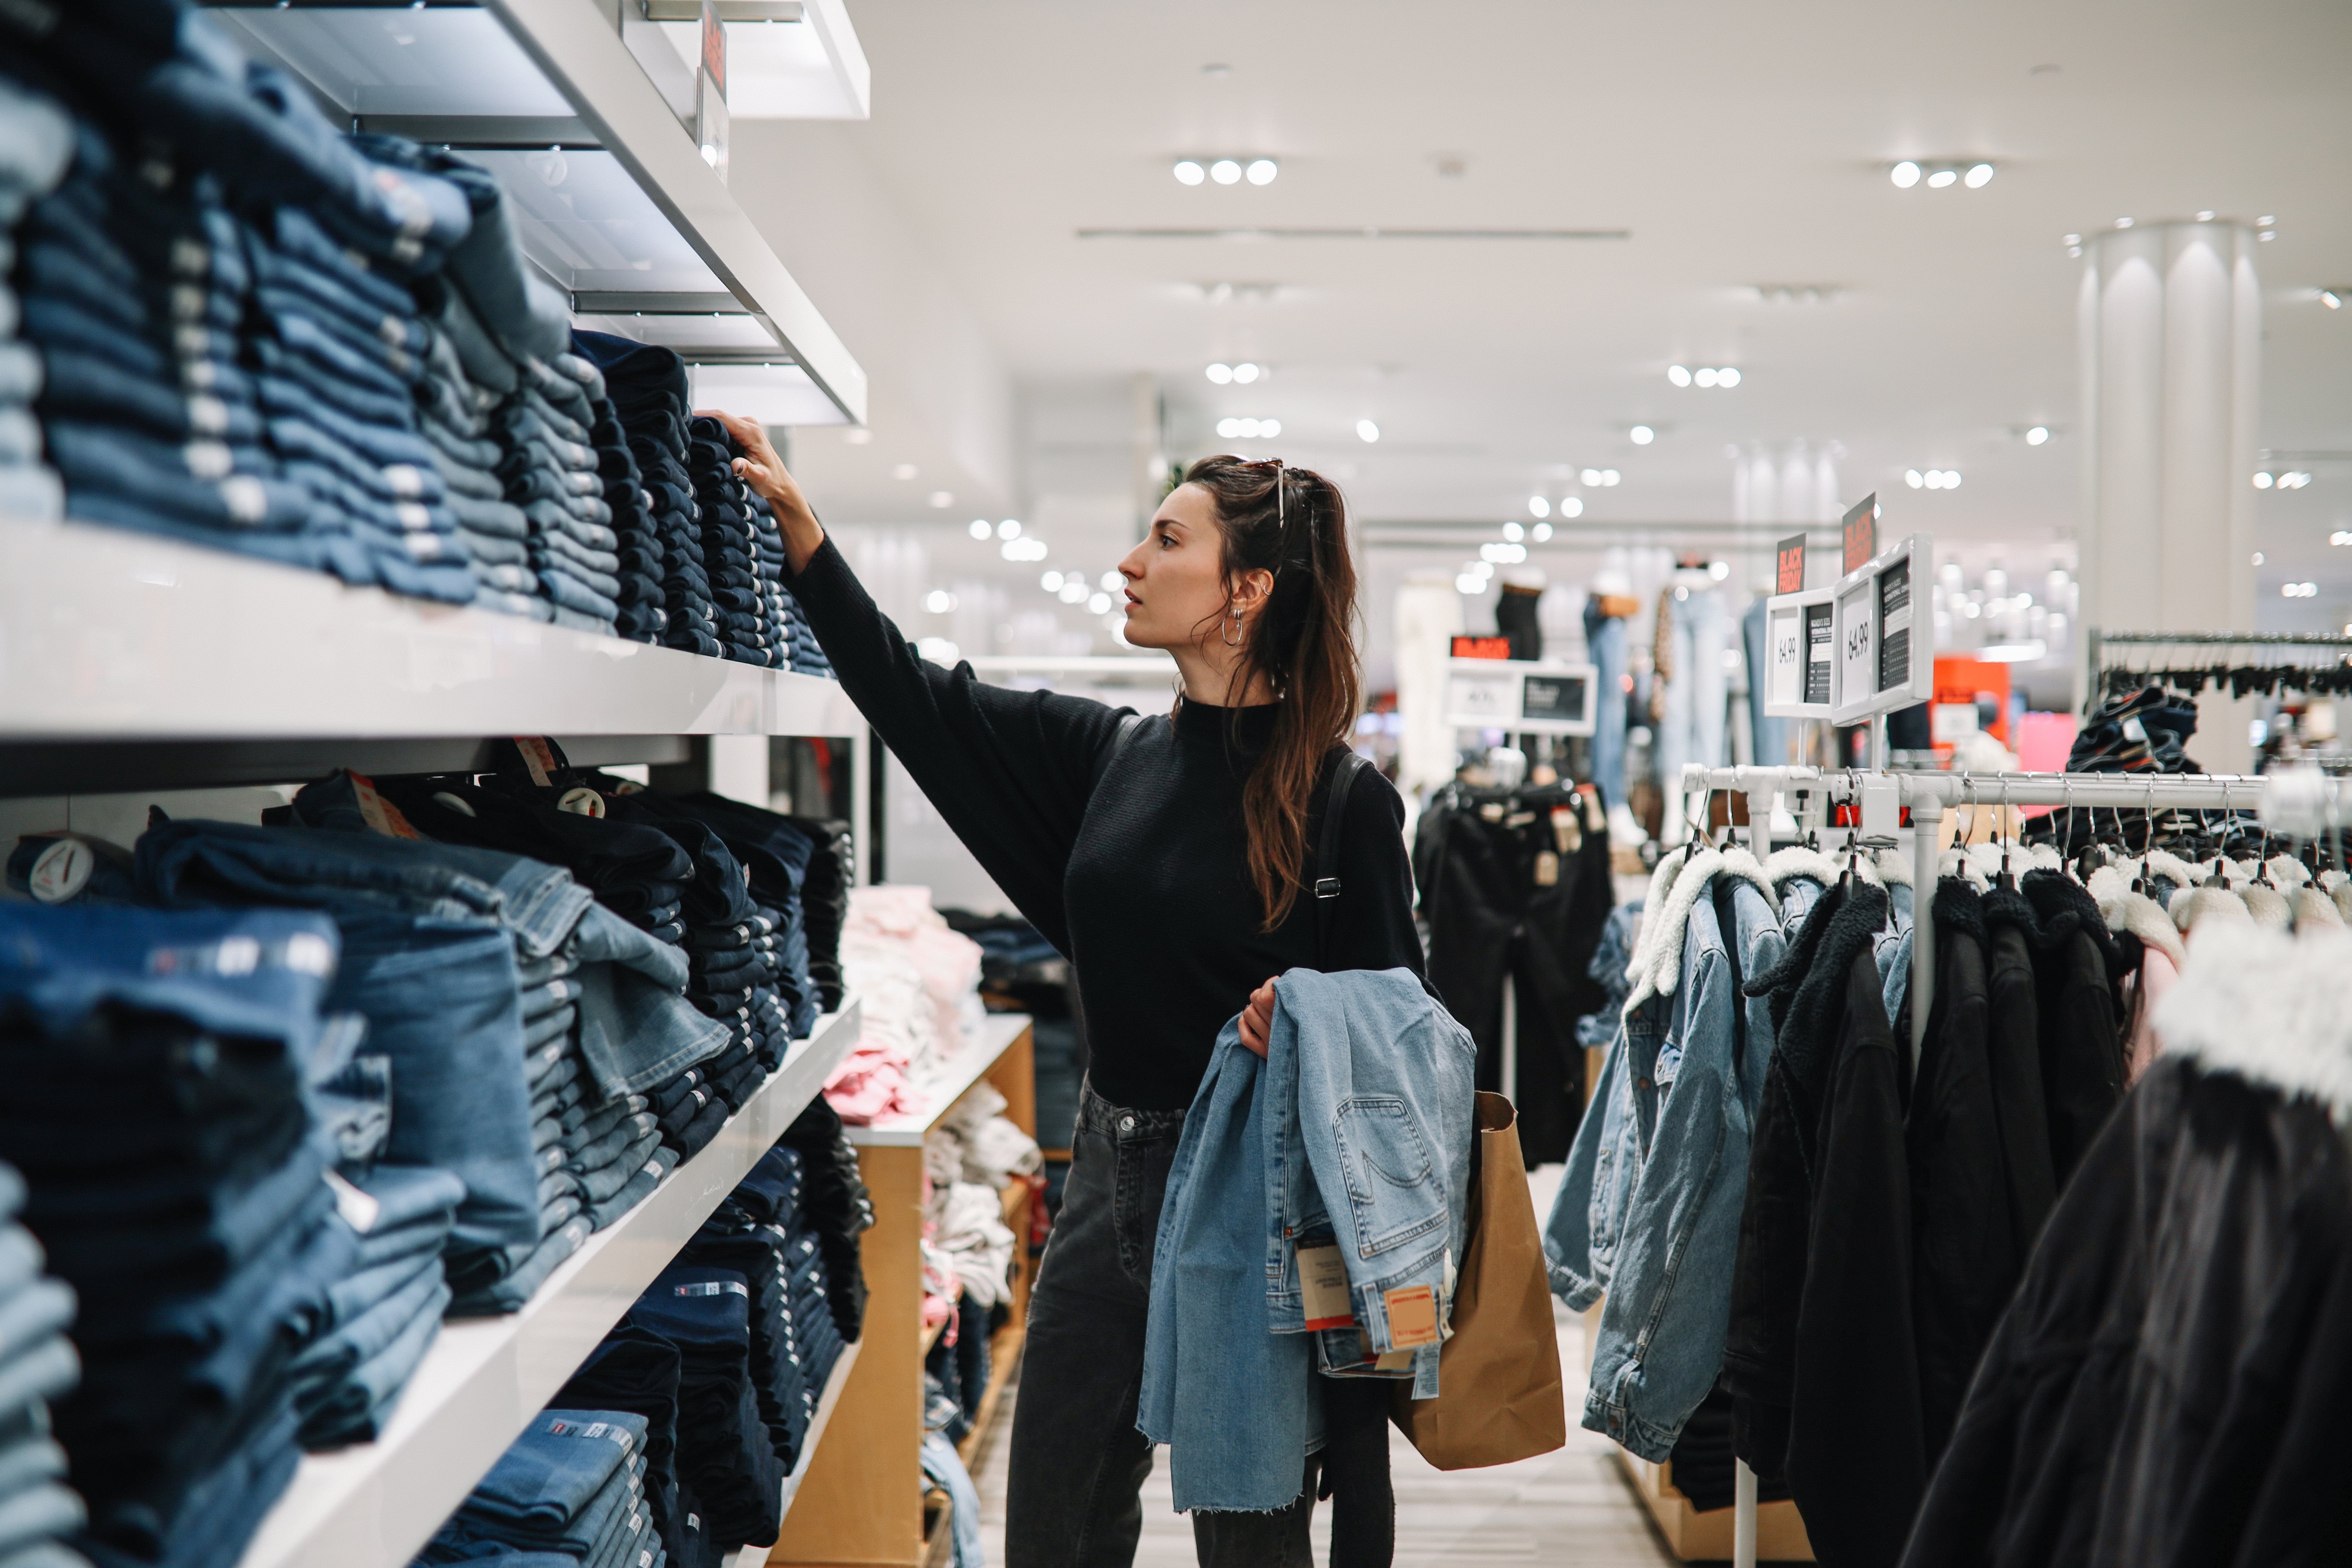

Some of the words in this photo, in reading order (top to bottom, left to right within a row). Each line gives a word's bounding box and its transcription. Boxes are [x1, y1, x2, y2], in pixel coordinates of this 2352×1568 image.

[1845, 510, 1873, 552] BLACK
[1779, 546, 1803, 573] BLACK
[1778, 569, 1802, 595] FRIDAY
[1780, 637, 1796, 663] 64.99
[1848, 621, 1868, 661] 64.99
